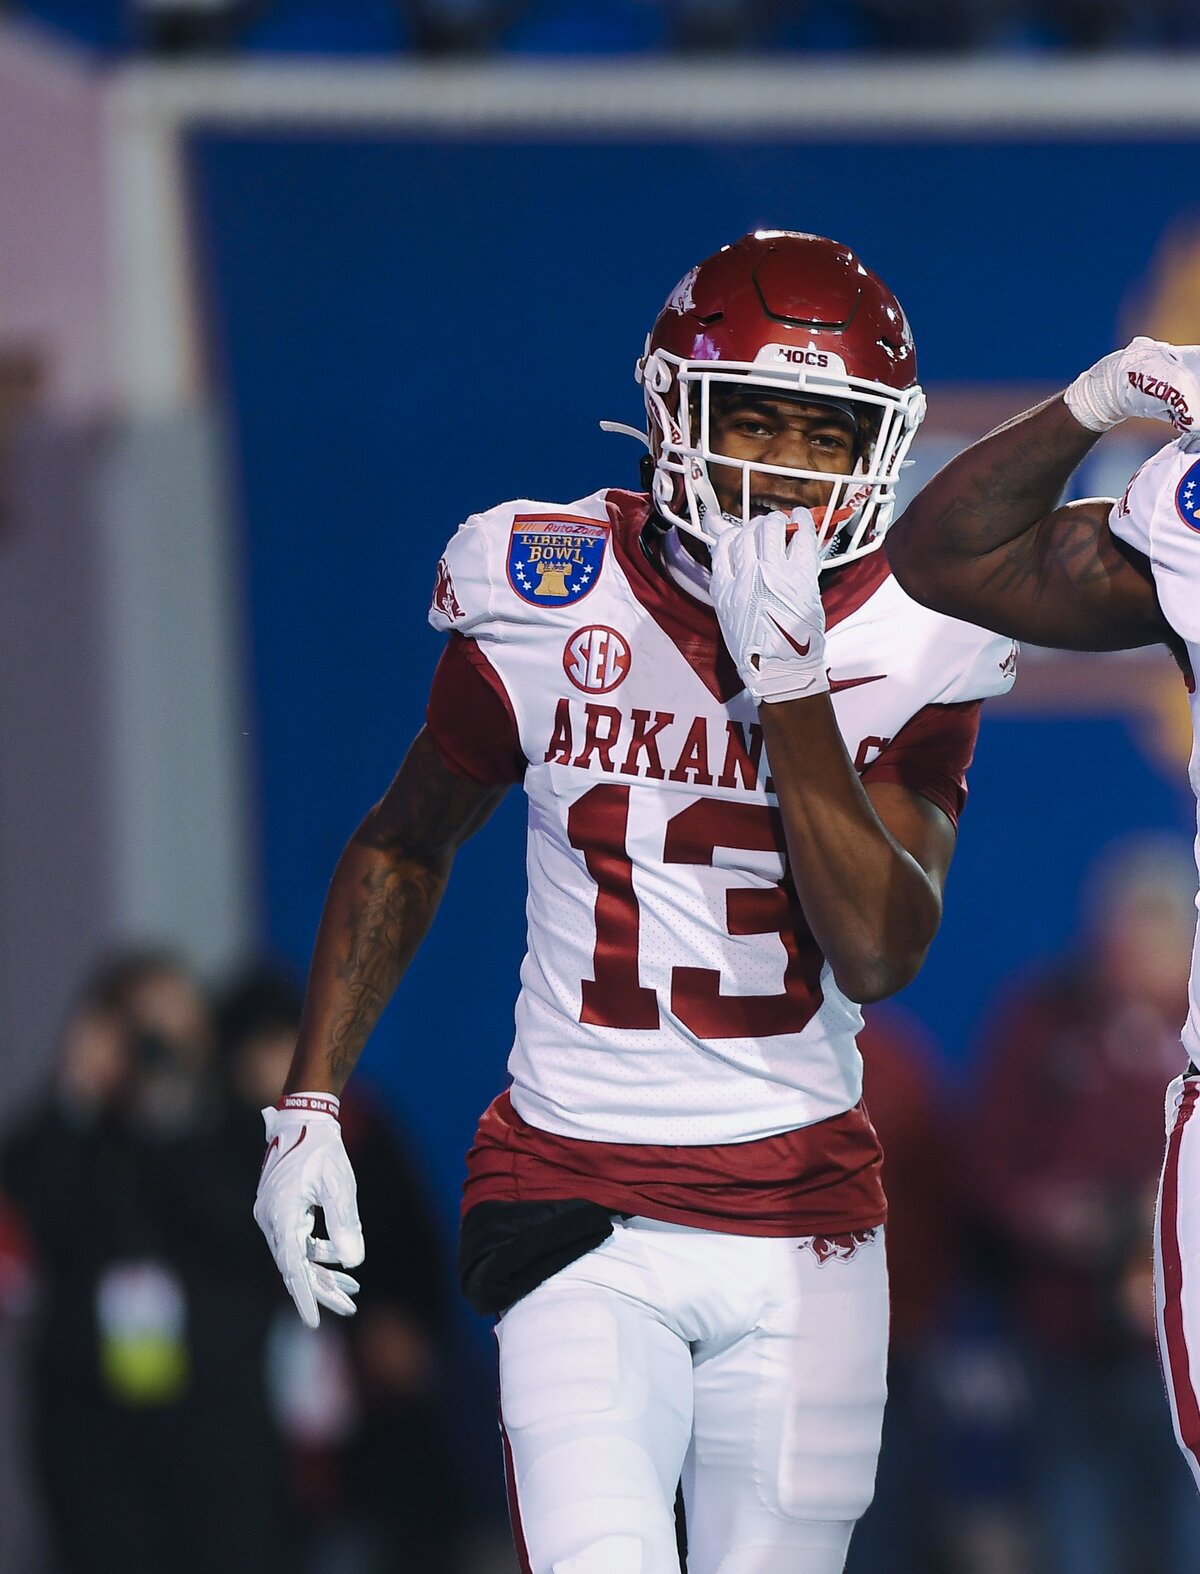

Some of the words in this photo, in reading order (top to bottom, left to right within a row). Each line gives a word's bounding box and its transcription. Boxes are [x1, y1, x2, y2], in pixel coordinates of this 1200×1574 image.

[520, 534, 598, 548] LIBERTY
[544, 523, 605, 537] AutoZone
[527, 546, 584, 564] BOWL
[565, 629, 628, 692] SEC
[544, 698, 887, 791] ARKAN
[567, 783, 825, 1040] 13
